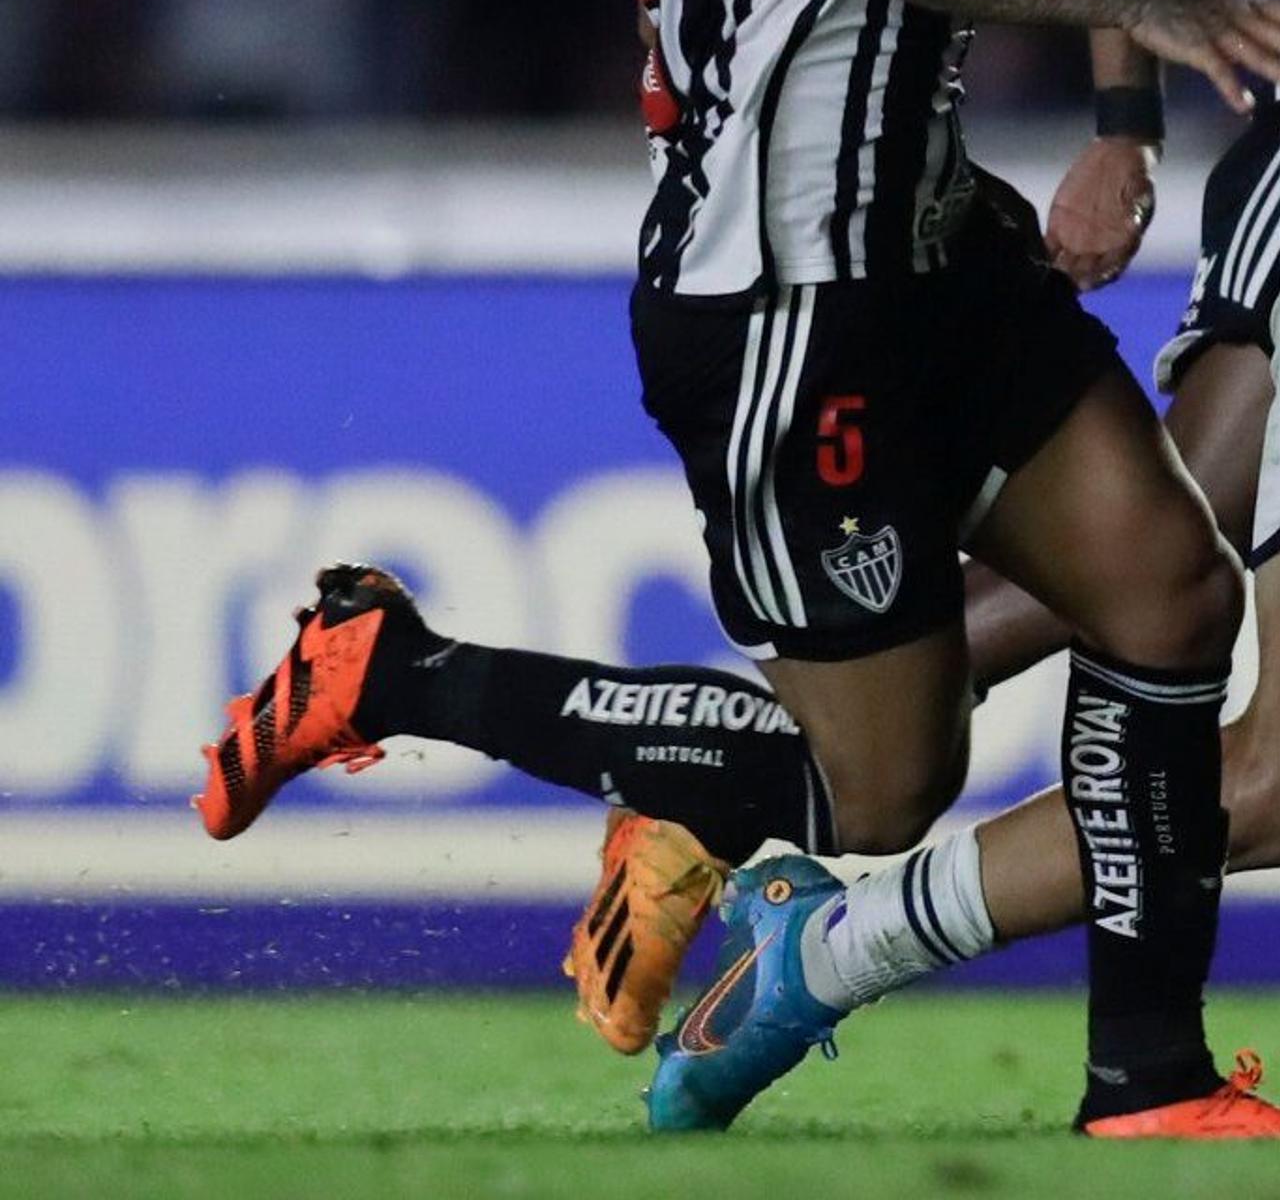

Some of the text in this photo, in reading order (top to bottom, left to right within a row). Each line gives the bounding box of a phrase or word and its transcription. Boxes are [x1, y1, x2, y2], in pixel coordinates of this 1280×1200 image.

[817, 395, 866, 487] 5
[838, 540, 888, 569] CAM
[561, 677, 698, 727] AZEITE
[636, 745, 723, 767] PORTUGAL
[1150, 770, 1175, 854] PORTUGAL
[1076, 807, 1140, 940] AZEITE
